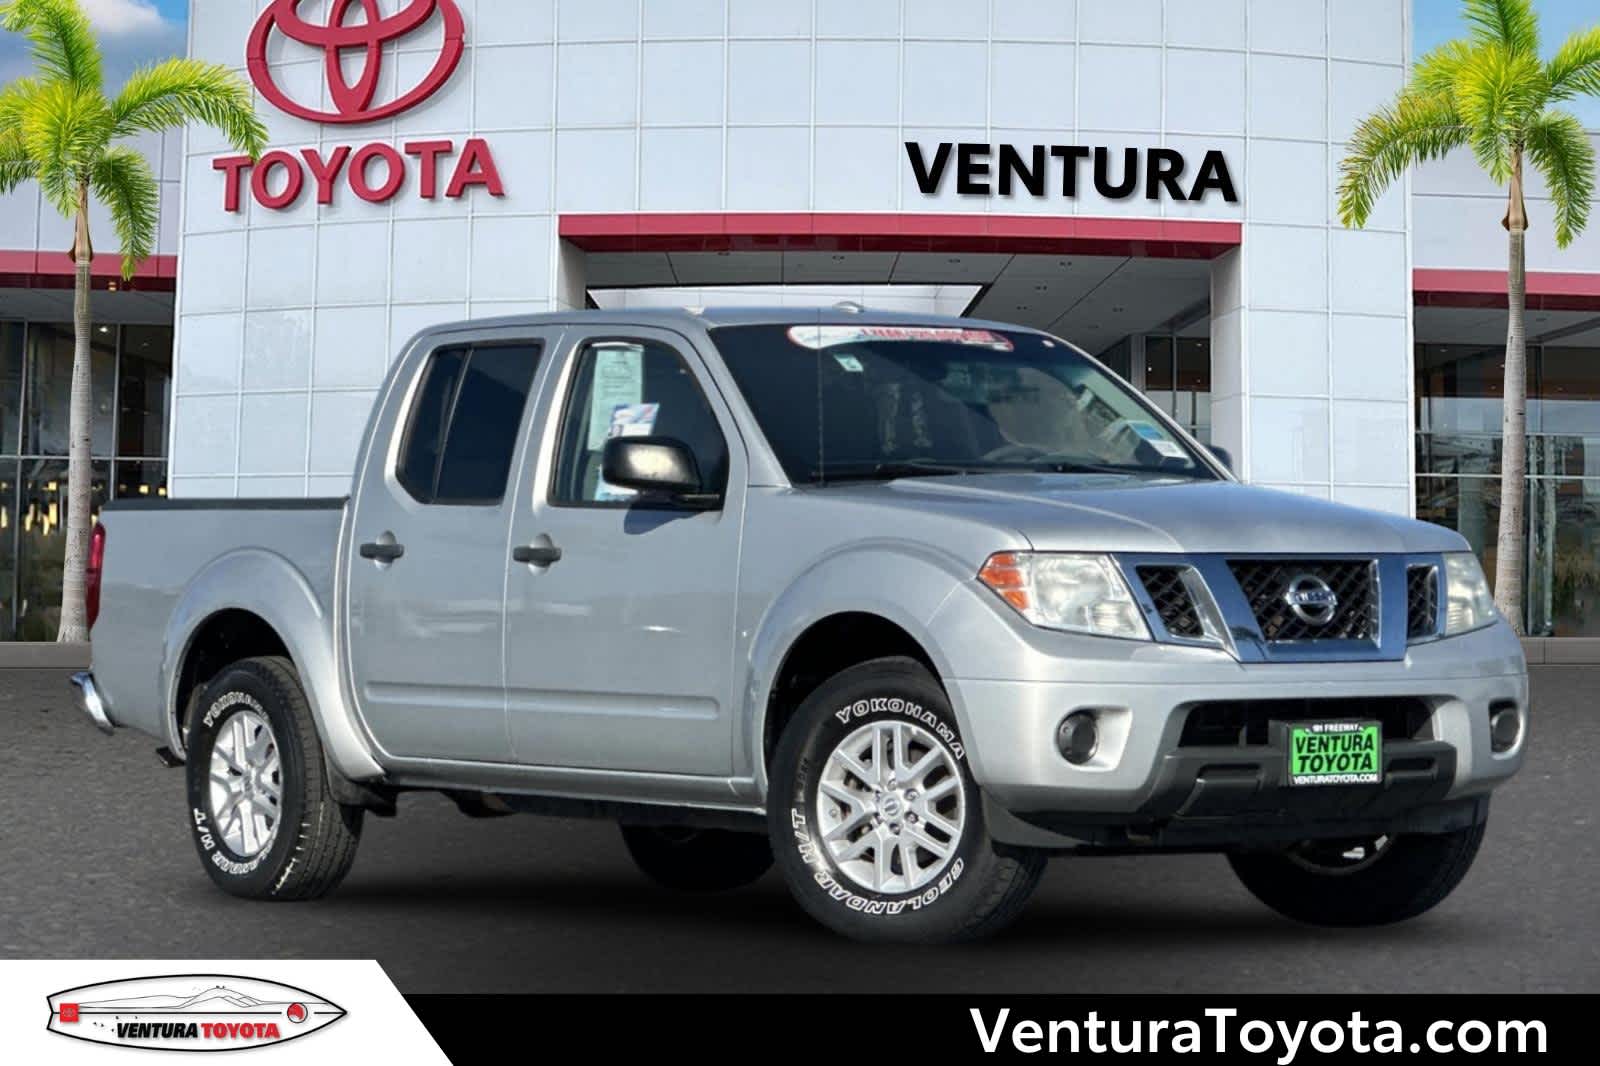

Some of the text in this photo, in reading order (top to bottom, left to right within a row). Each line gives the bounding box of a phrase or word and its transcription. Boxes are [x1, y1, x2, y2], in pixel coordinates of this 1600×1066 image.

[213, 138, 504, 212] TOYOTA
[904, 142, 1239, 203] VENTURA
[835, 697, 965, 760] YOKOHAMA
[1295, 735, 1374, 753] VENTURA
[1293, 773, 1378, 784] VENTURATOYOTA.COM
[1298, 753, 1373, 772] TOYOTA
[814, 857, 965, 915] GEOLANDAR
